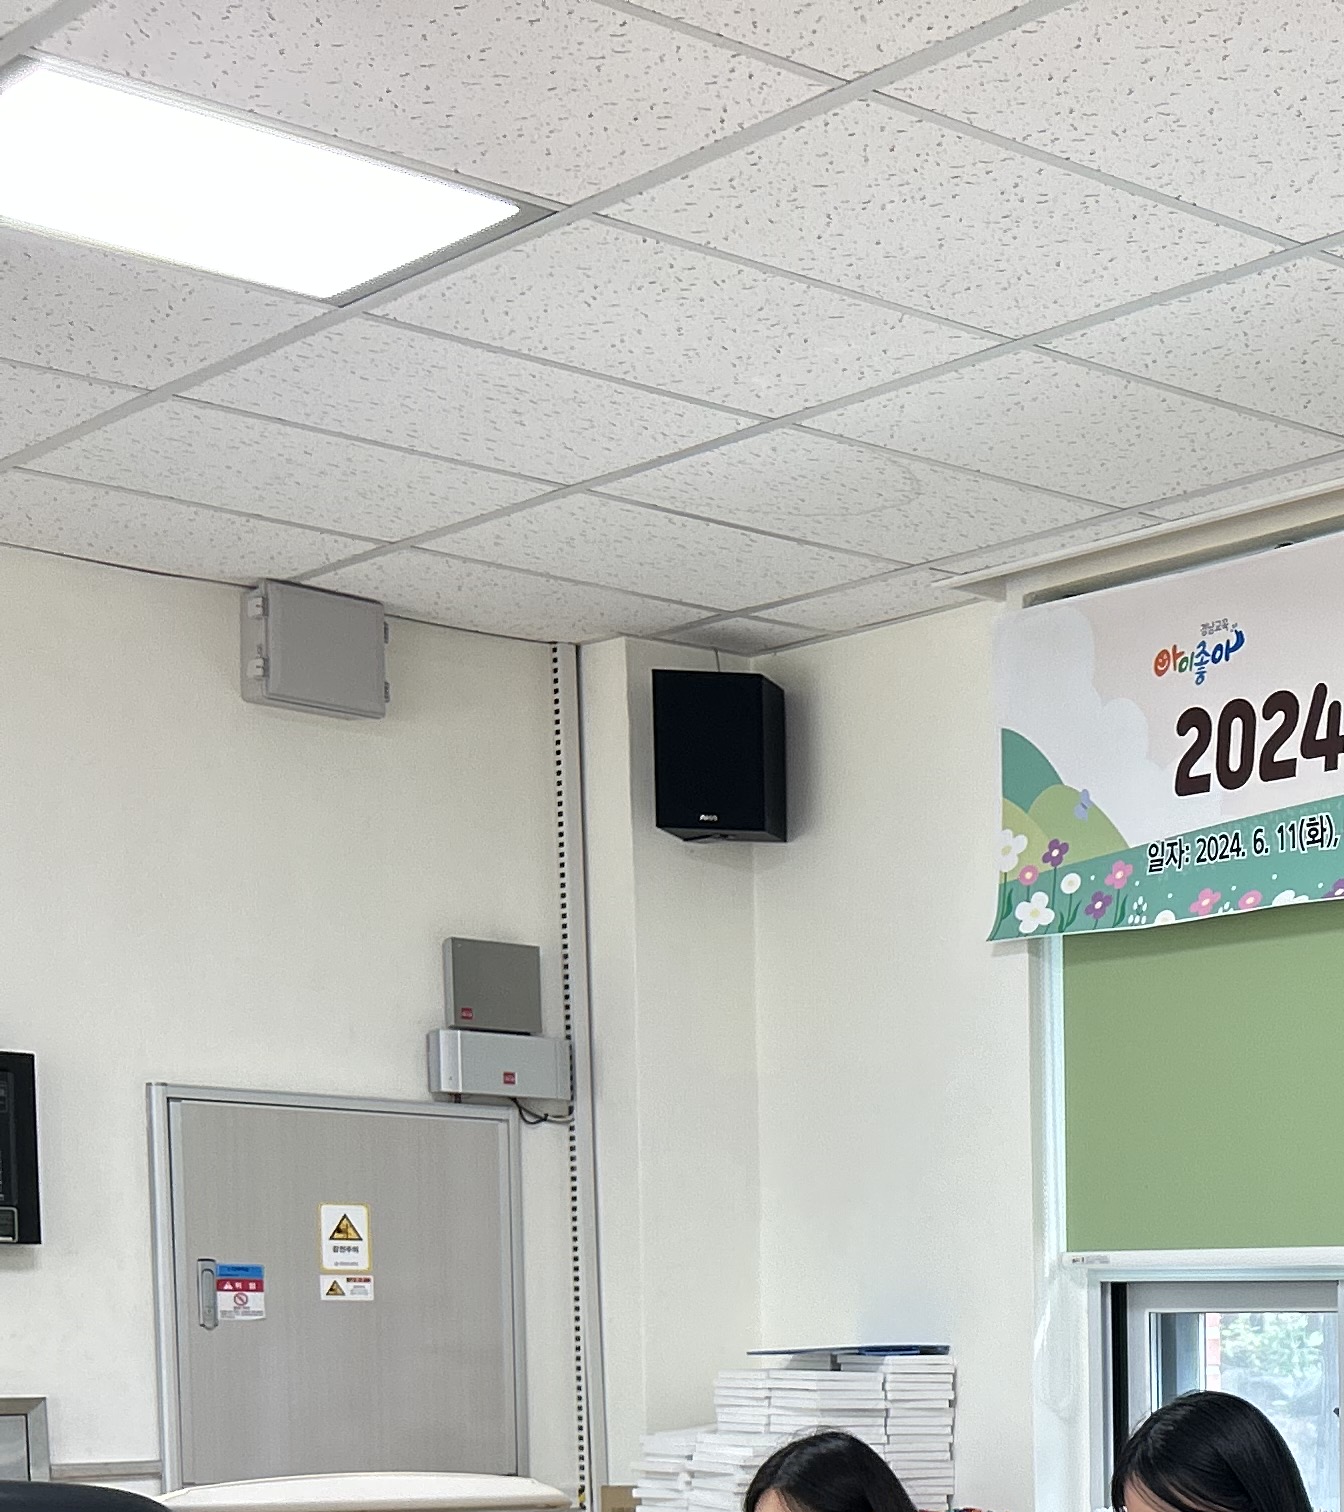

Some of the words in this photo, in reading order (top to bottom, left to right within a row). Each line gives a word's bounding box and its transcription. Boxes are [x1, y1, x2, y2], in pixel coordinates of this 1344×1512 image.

[1153, 629, 1245, 686] 아이좋아
[1147, 838, 1191, 874] 일자:
[1195, 831, 1246, 866] 2024.
[1253, 828, 1270, 856] 6.
[1276, 814, 1340, 853] 11(화),
